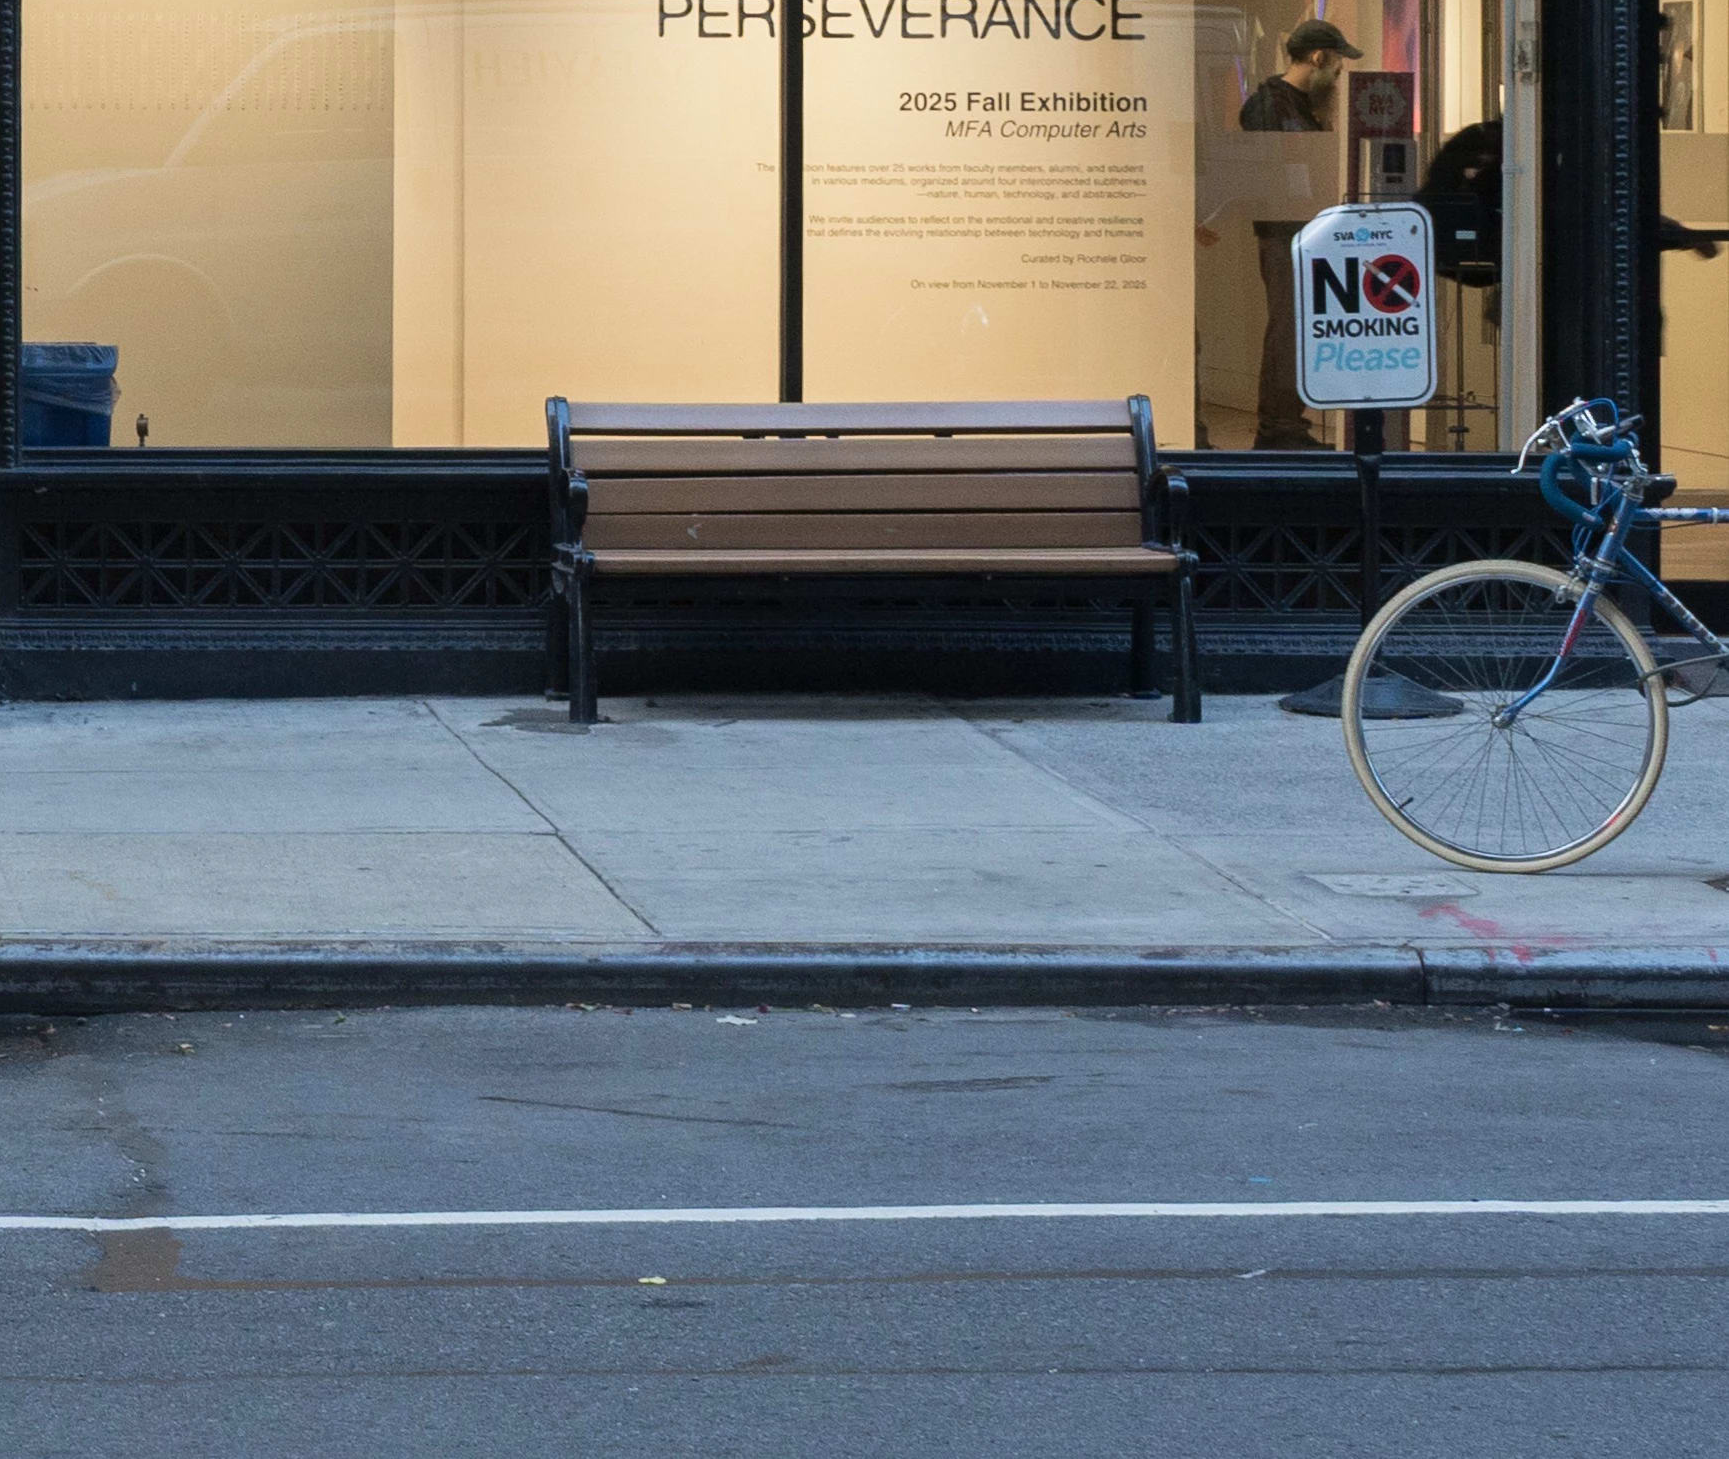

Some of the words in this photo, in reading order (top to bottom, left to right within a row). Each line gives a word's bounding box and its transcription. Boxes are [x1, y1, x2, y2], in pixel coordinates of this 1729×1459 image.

[899, 92, 958, 113] 2025
[966, 92, 1012, 113] Fall
[1021, 92, 1148, 113] Exhibition
[945, 120, 994, 139] MFA
[1000, 119, 1101, 142] Computer
[1106, 120, 1147, 139] Arts
[757, 163, 775, 172] The
[826, 163, 866, 172] features
[908, 163, 936, 172] works
[939, 163, 962, 172] from
[963, 163, 995, 174] faculty
[1086, 163, 1106, 172] and
[823, 177, 857, 185] various
[910, 177, 959, 187] organized
[961, 177, 995, 185] around
[997, 177, 1018, 185] four
[1019, 177, 1091, 185] interconnected
[1093, 177, 1147, 185] subthemes
[1061, 190, 1080, 199] and
[828, 215, 854, 224] invite
[856, 215, 905, 224] audiences
[920, 215, 951, 224] reflect
[967, 215, 983, 224] the
[986, 215, 1033, 224] emotional
[1035, 215, 1054, 224] and
[1056, 215, 1095, 224] creative
[1097, 215, 1144, 224] resilience
[807, 228, 826, 237] that
[828, 228, 863, 237] defines
[865, 228, 881, 237] the
[883, 228, 924, 239] evolving
[926, 228, 983, 239] relationship
[984, 228, 1027, 237] between
[1028, 228, 1080, 239] technology
[1083, 228, 1102, 237] and
[1333, 232, 1355, 241] SVA
[1370, 230, 1393, 240] NYC
[1021, 254, 1060, 264] Curated
[928, 279, 950, 289] view
[952, 279, 975, 289] from
[977, 279, 1028, 289] November
[1051, 279, 1102, 289] November
[1122, 279, 1147, 289] 2025
[1312, 317, 1419, 338] SMOKING
[1313, 342, 1421, 372] Please
